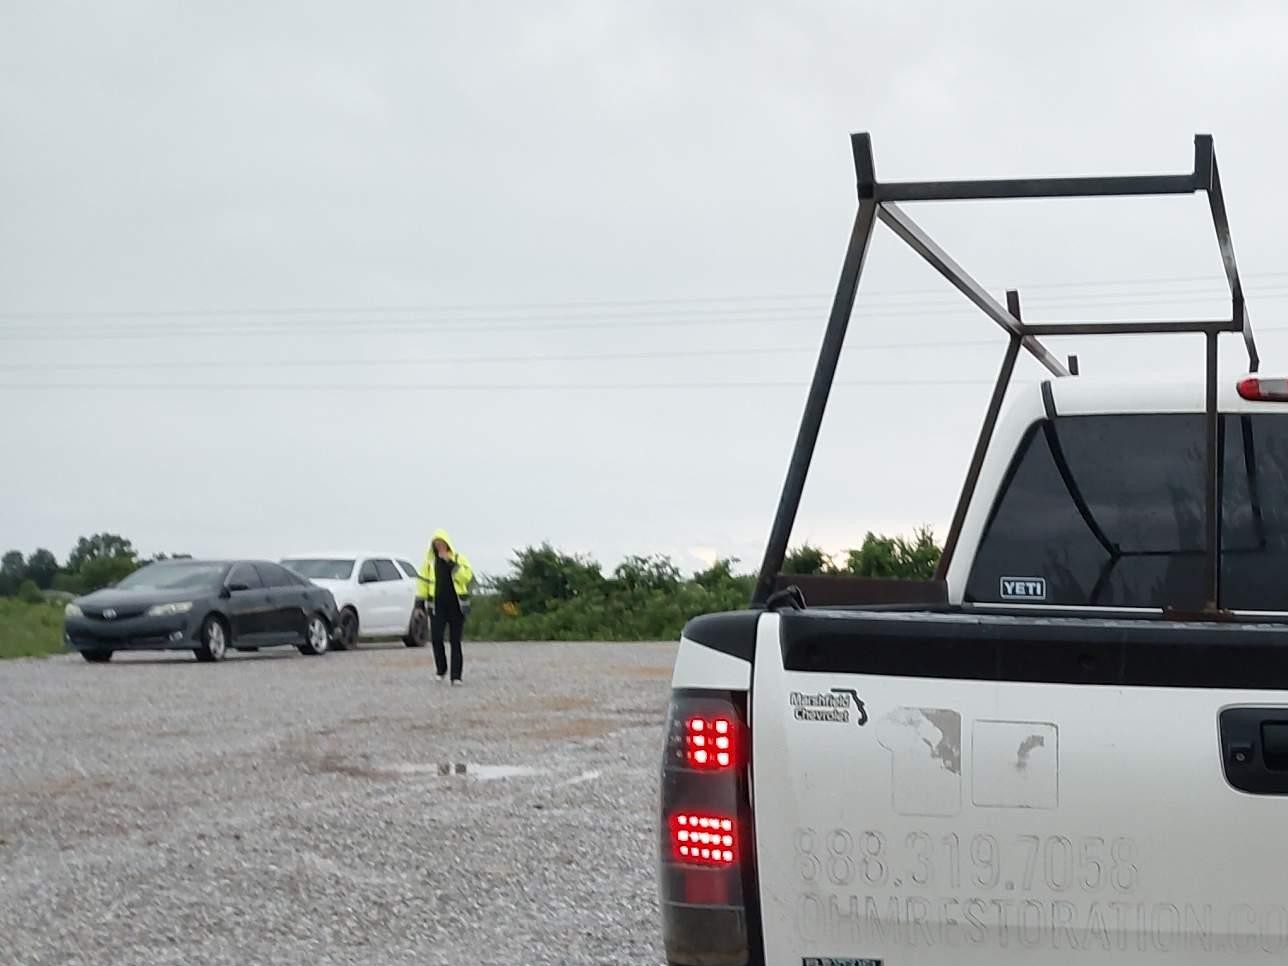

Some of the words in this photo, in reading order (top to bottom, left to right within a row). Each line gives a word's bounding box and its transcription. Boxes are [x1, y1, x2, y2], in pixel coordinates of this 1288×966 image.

[1004, 581, 1042, 595] YETI
[789, 692, 850, 708] Marshfield
[794, 708, 850, 723] Chevrolet
[793, 827, 1140, 893] 888.319.7058
